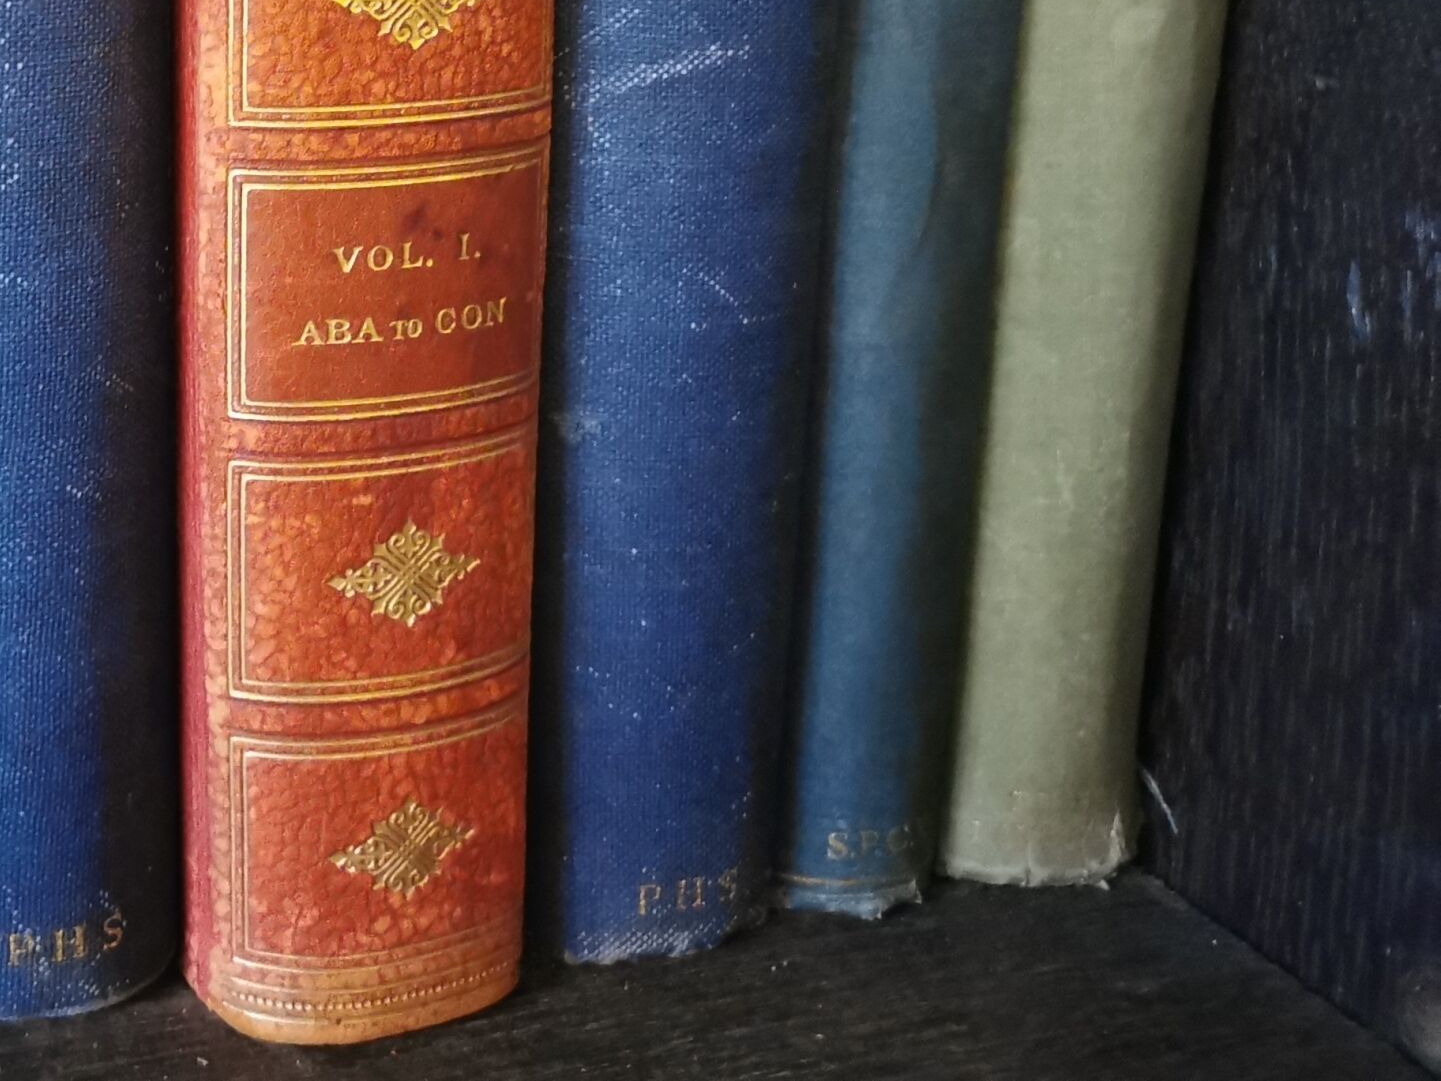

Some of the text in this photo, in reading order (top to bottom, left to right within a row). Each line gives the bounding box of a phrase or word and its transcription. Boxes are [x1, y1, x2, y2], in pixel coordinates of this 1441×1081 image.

[331, 232, 482, 274] VOL. I.
[290, 296, 507, 347] ABA TO CON
